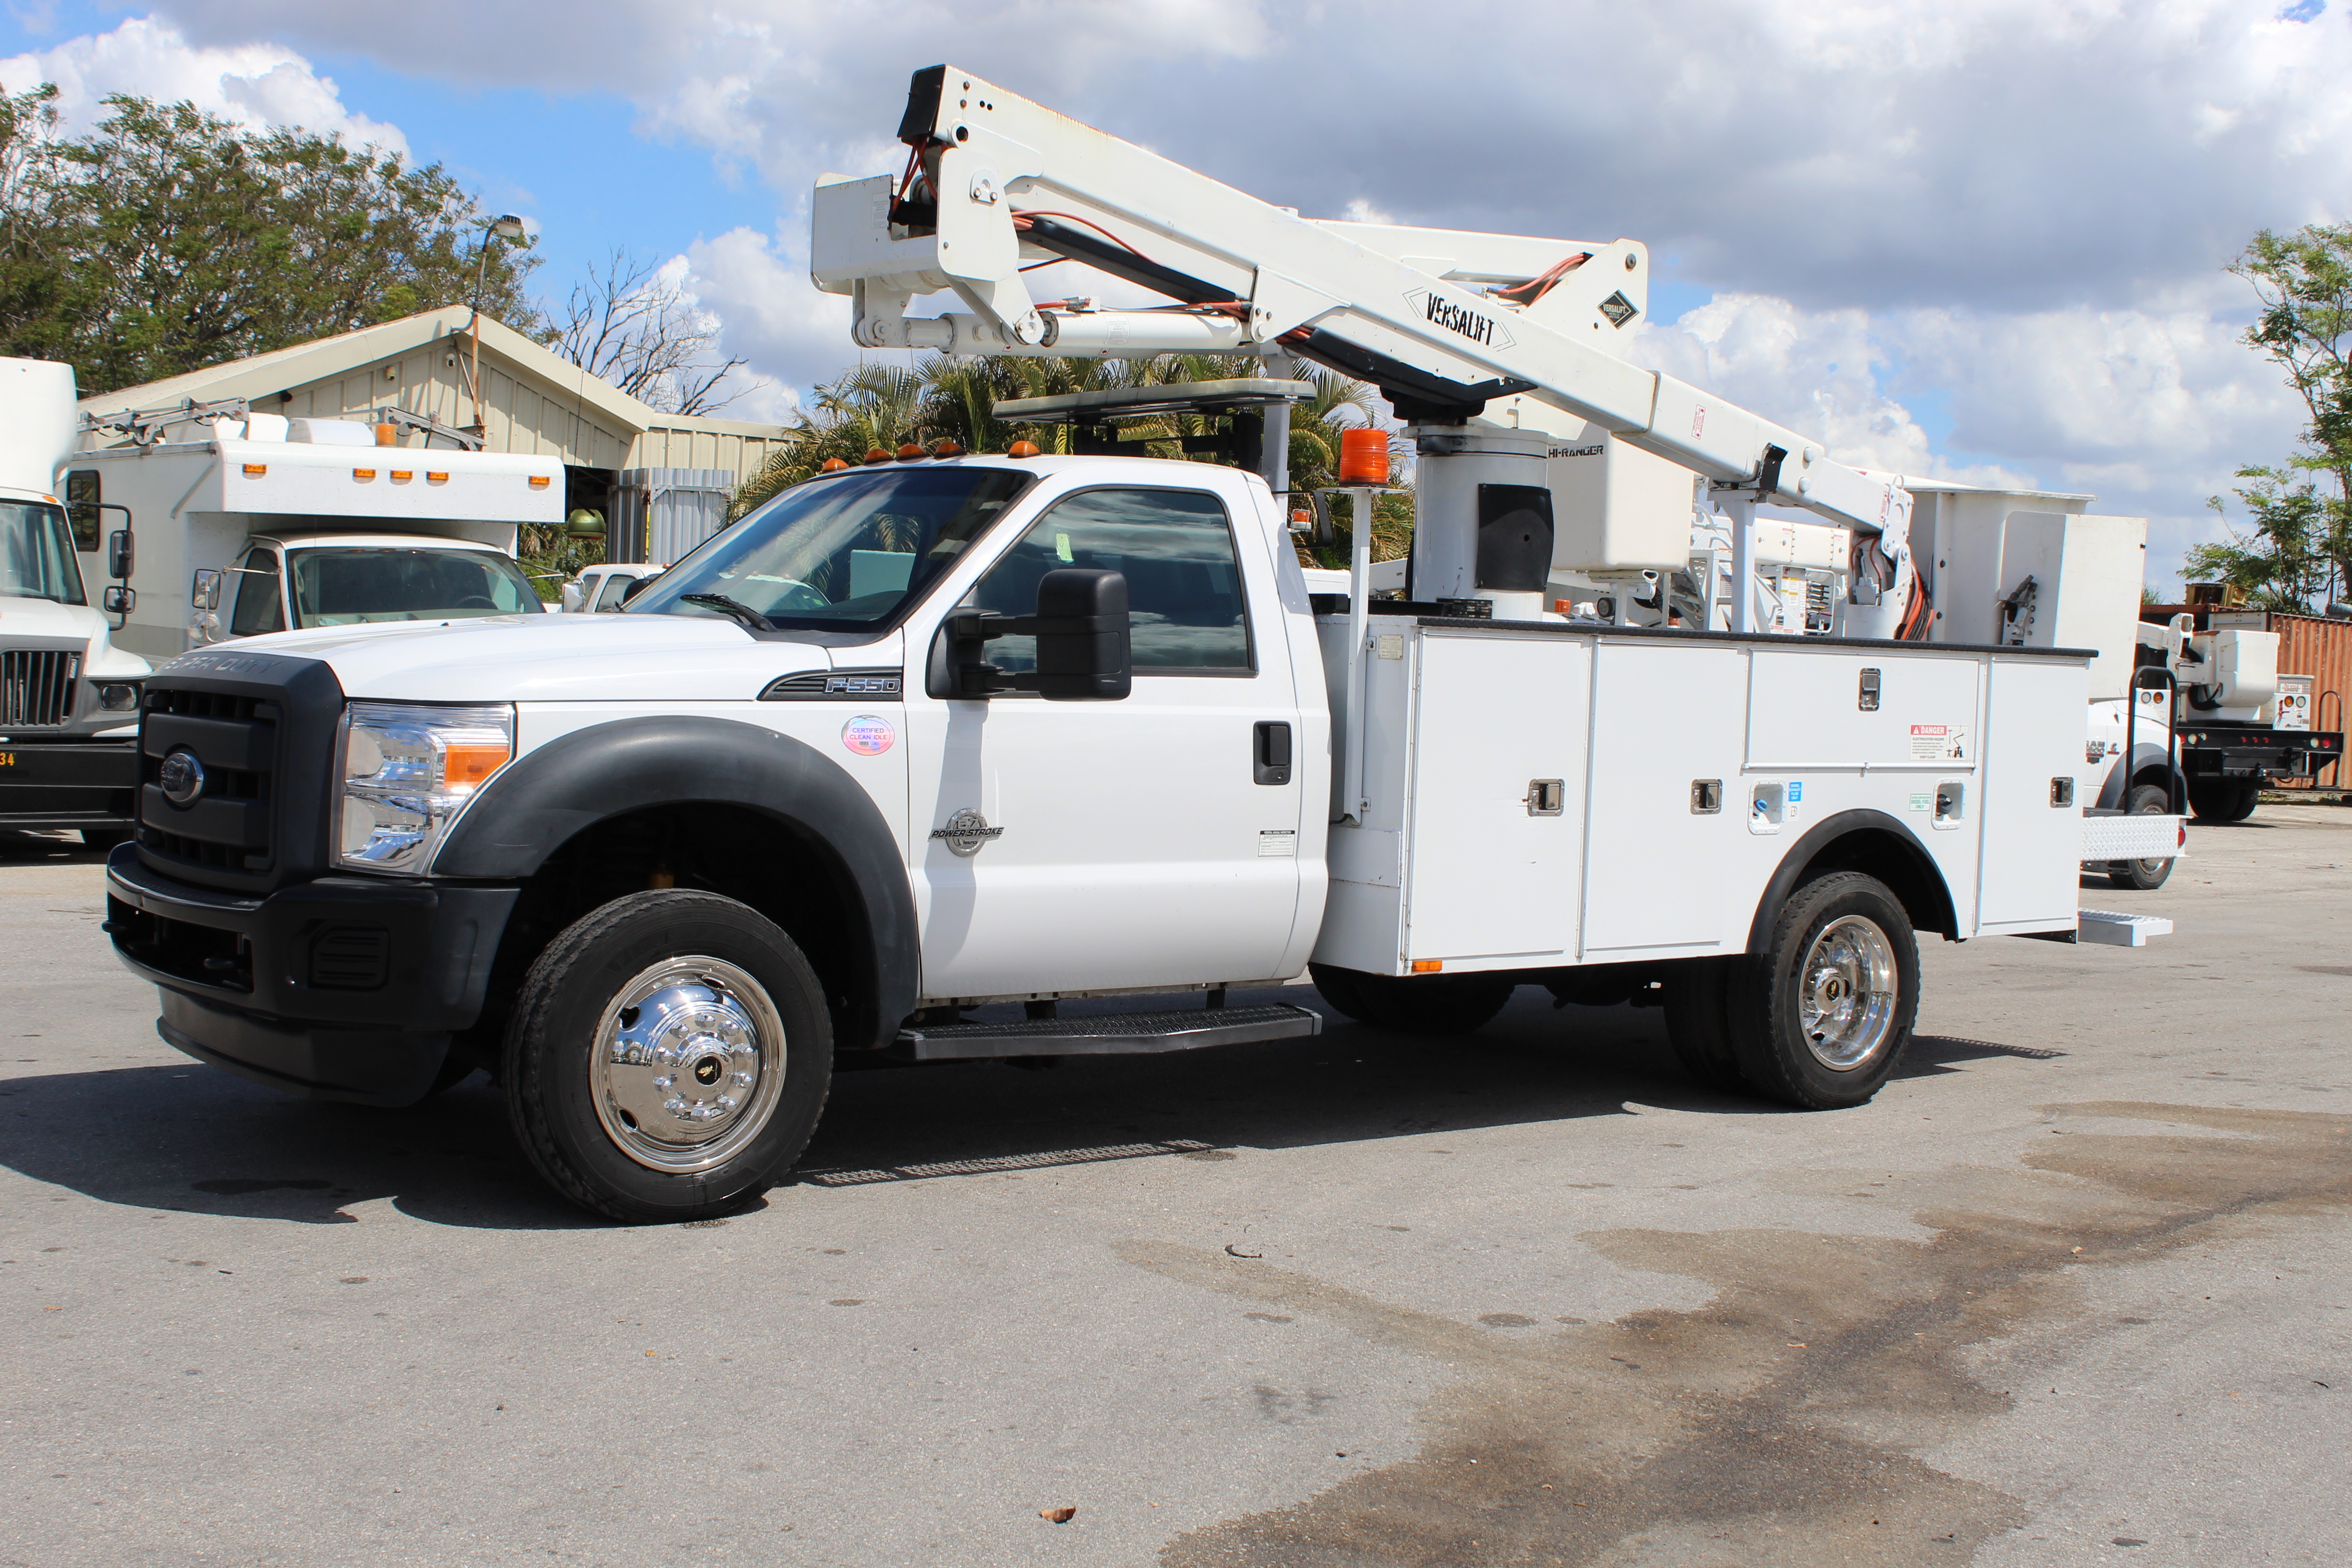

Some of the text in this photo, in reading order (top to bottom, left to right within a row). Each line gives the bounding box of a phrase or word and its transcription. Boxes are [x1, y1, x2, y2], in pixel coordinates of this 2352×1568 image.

[1602, 303, 1626, 314] VERSALIFT
[1427, 292, 1495, 347] VERSALIFT
[1548, 445, 1604, 458] HI-RANGER
[164, 657, 285, 674] SUPER DUTY
[825, 678, 901, 693] F-550
[0, 753, 15, 766] 34
[931, 827, 1004, 838] POWER STROKE
